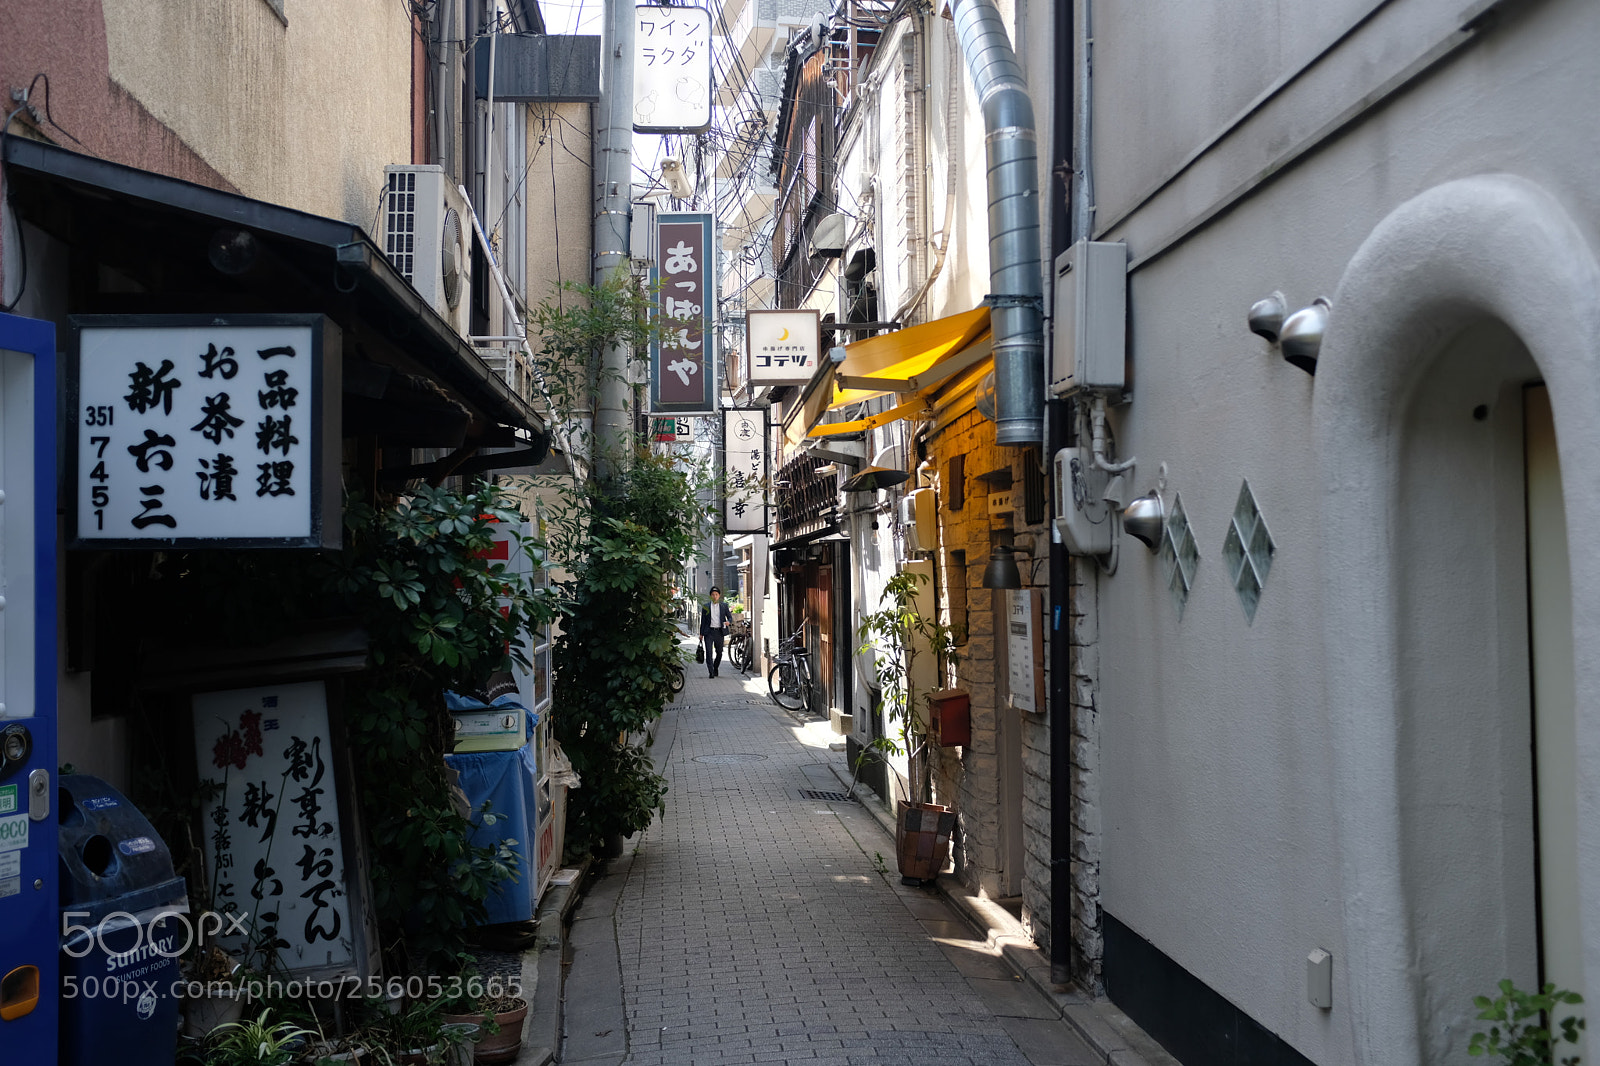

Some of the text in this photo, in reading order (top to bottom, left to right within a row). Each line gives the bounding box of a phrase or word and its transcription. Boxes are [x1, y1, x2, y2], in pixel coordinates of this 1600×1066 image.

[640, 19, 700, 37] ワイン
[642, 40, 704, 67] ラクダ
[756, 354, 808, 367] コテツ
[123, 359, 182, 530] 新六三
[190, 342, 244, 502] お茶漬
[255, 345, 299, 498] 一品料理
[85, 405, 114, 531] 351 7451
[116, 957, 171, 984] SUNTORY FOODS
